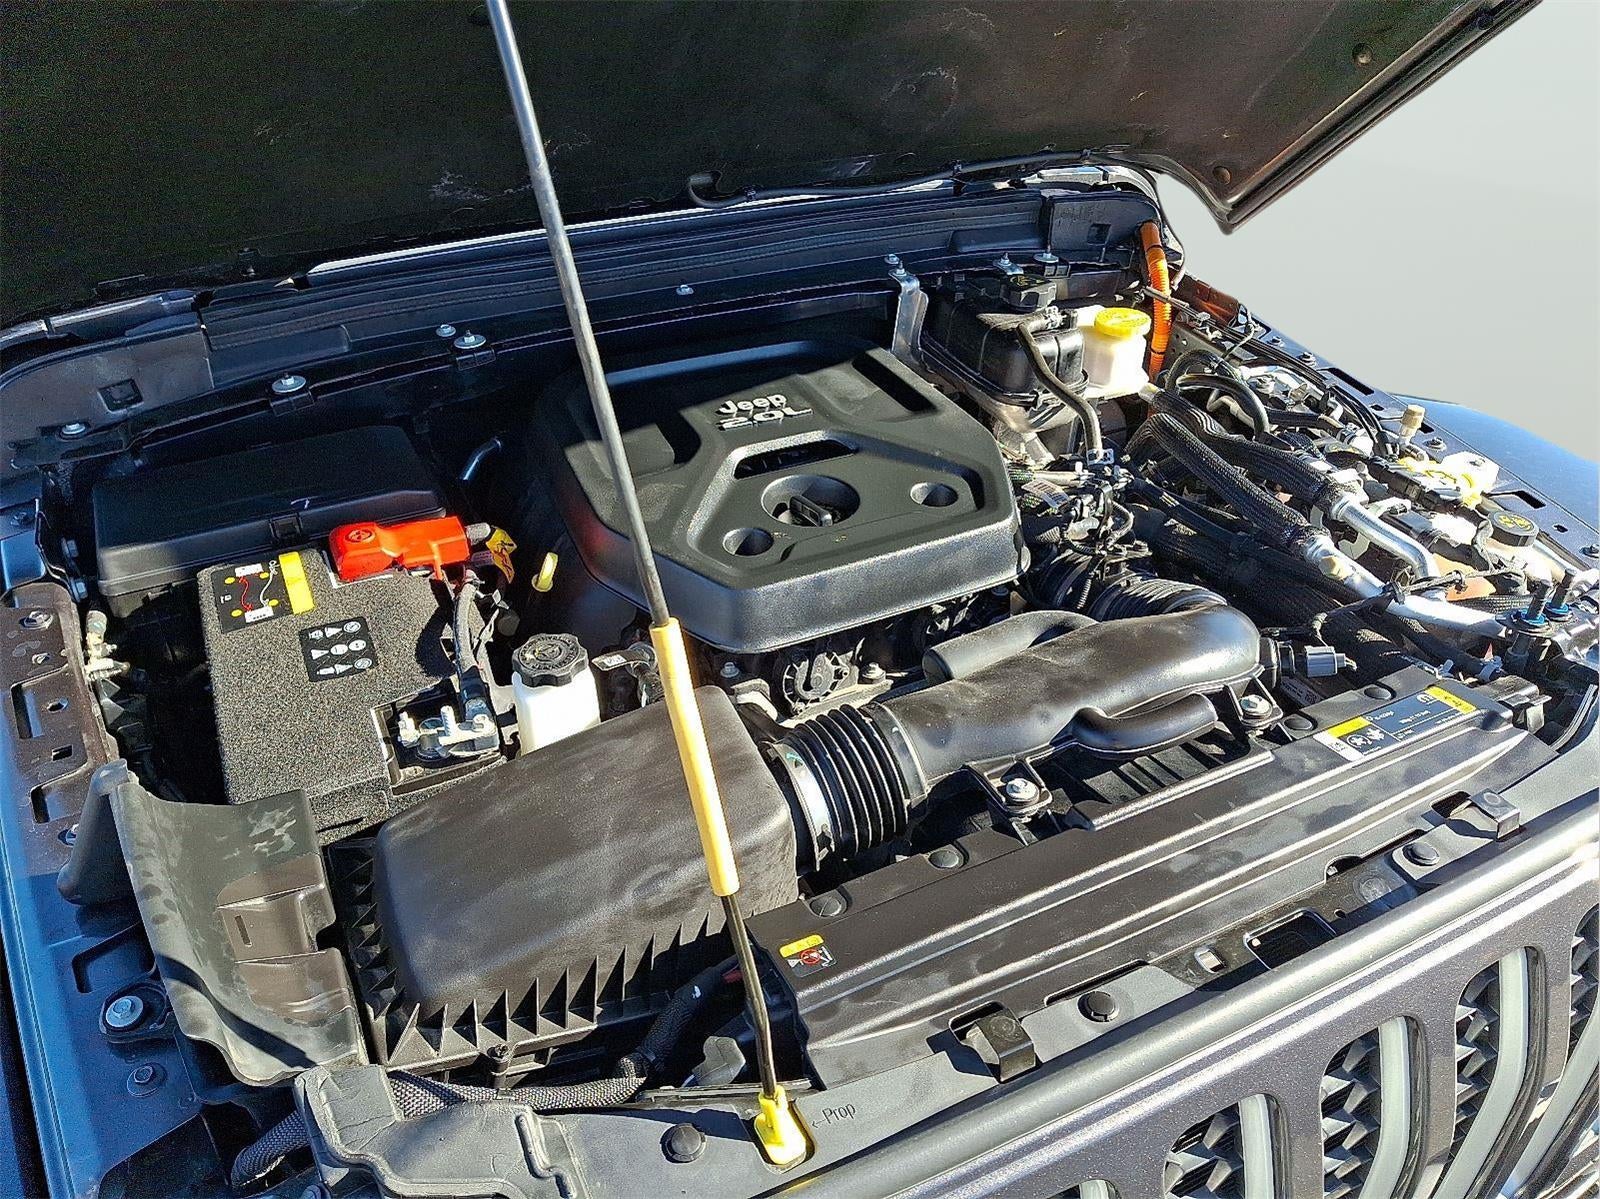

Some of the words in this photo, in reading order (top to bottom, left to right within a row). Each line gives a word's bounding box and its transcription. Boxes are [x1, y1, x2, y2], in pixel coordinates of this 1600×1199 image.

[719, 394, 787, 415] Jeep
[719, 407, 813, 430] 2.0L
[822, 1103, 856, 1124] Prop
